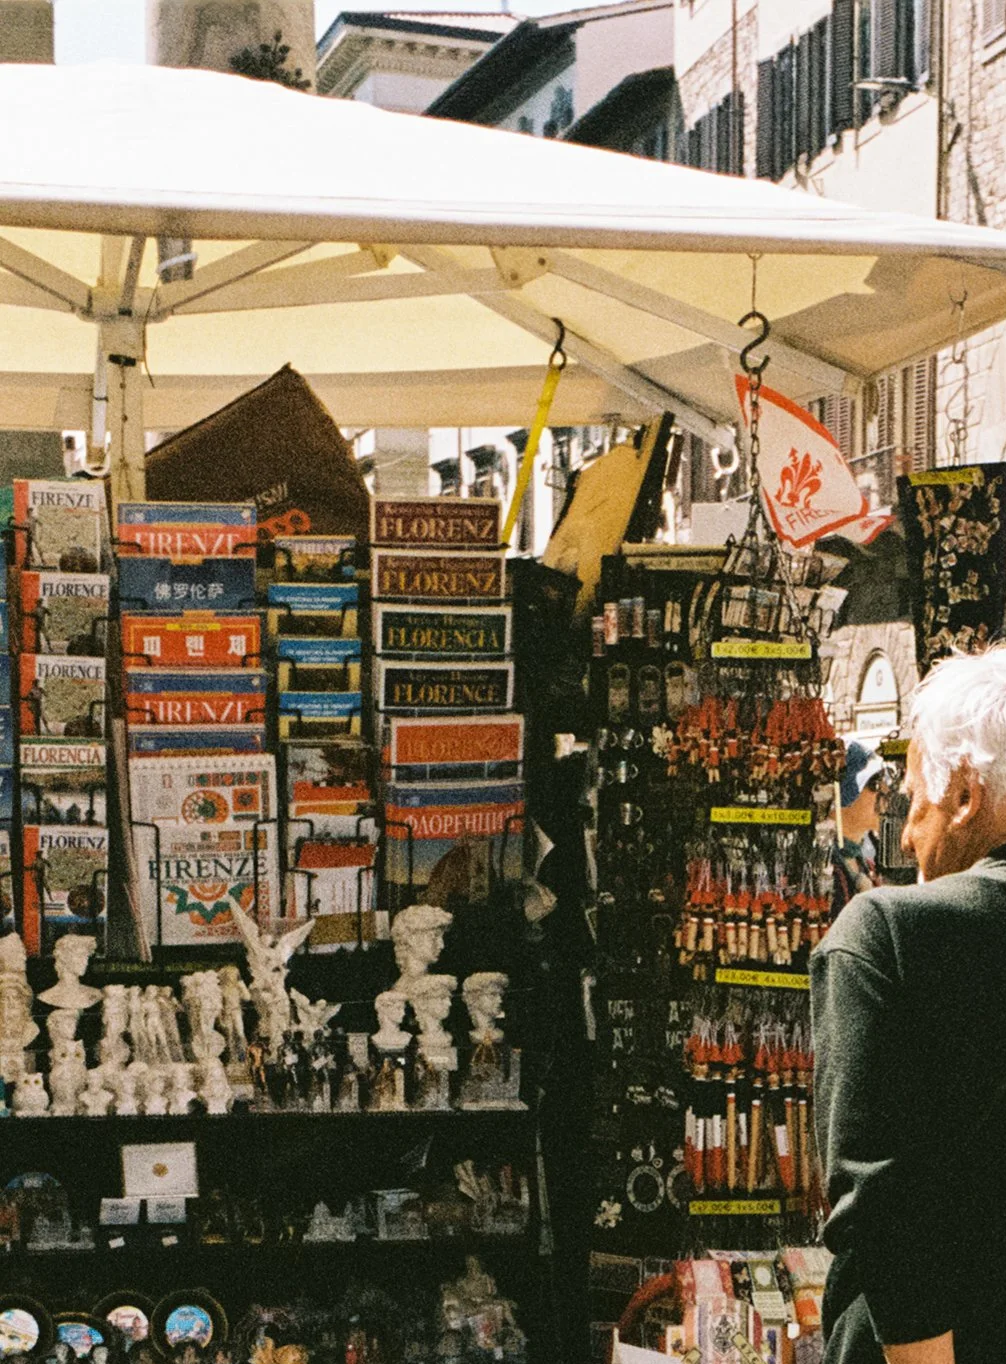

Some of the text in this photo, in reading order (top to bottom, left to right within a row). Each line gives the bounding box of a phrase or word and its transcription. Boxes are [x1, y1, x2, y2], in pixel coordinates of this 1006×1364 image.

[32, 491, 94, 508] FIRENZE
[380, 516, 494, 539] FLORENZ
[135, 532, 240, 559] FIRENZE
[42, 582, 107, 598] FLORENCE
[383, 571, 497, 595] FLORENZ
[388, 626, 499, 649] FLORENCIA
[38, 663, 102, 679] FLORENCE
[392, 683, 499, 705] FLORENCE
[143, 700, 250, 722] FIRENZE
[22, 746, 101, 764] FLORENCIA
[40, 834, 106, 850] FLORENZ
[147, 855, 269, 880] FIRENZE
